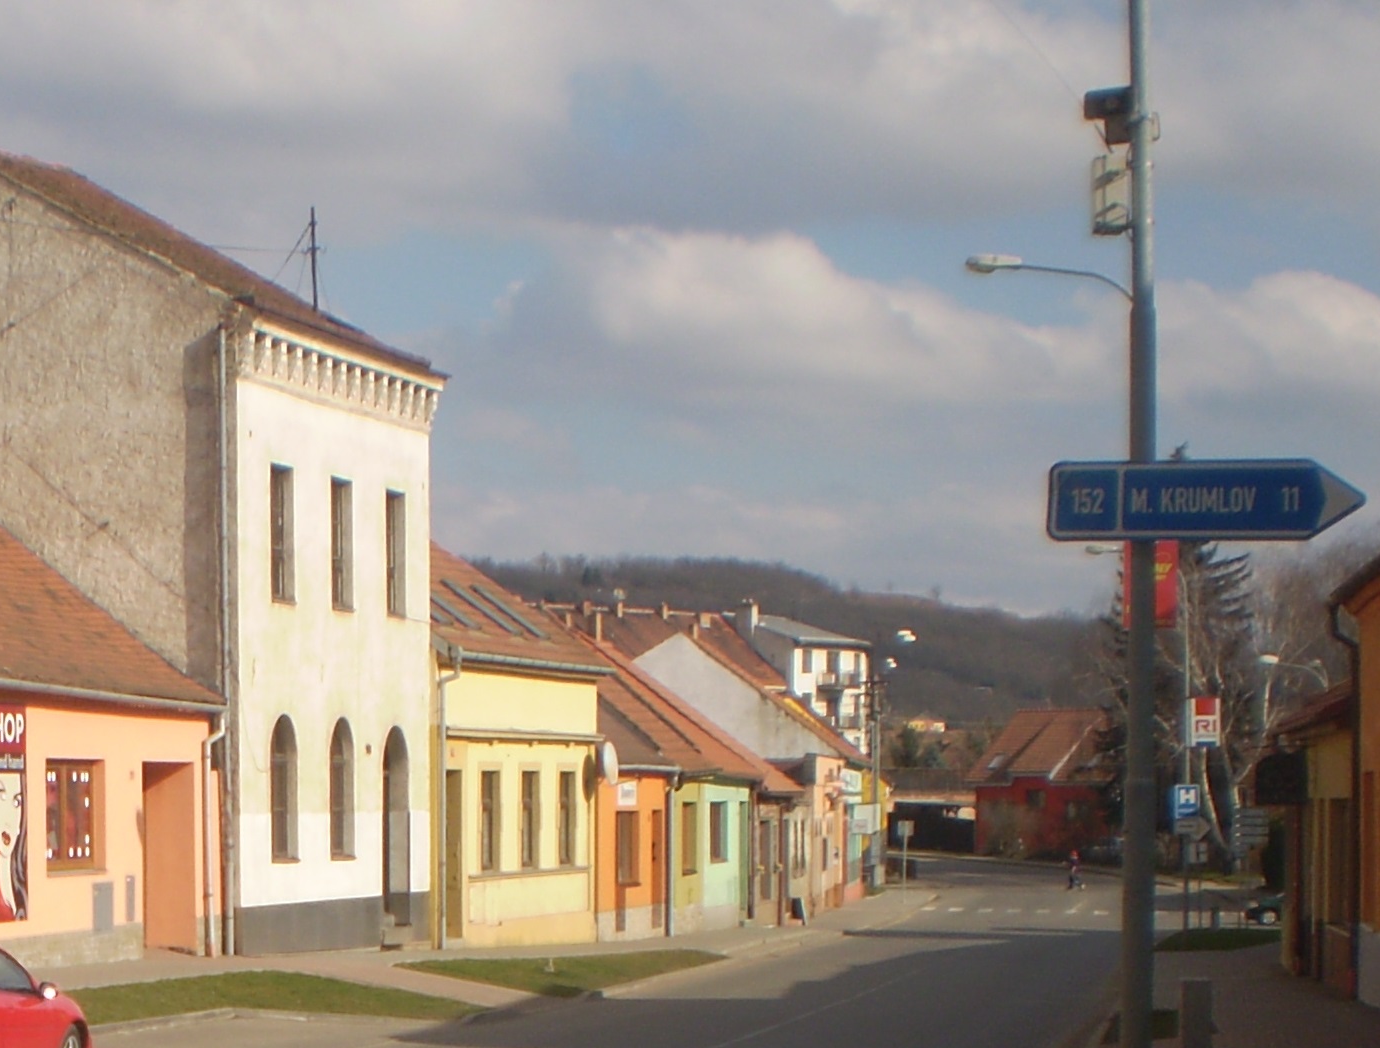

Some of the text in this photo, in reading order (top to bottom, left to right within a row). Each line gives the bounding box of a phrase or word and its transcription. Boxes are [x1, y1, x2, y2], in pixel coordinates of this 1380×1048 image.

[1072, 488, 1105, 514] 152
[1131, 486, 1300, 513] M. KRUMLOV 11
